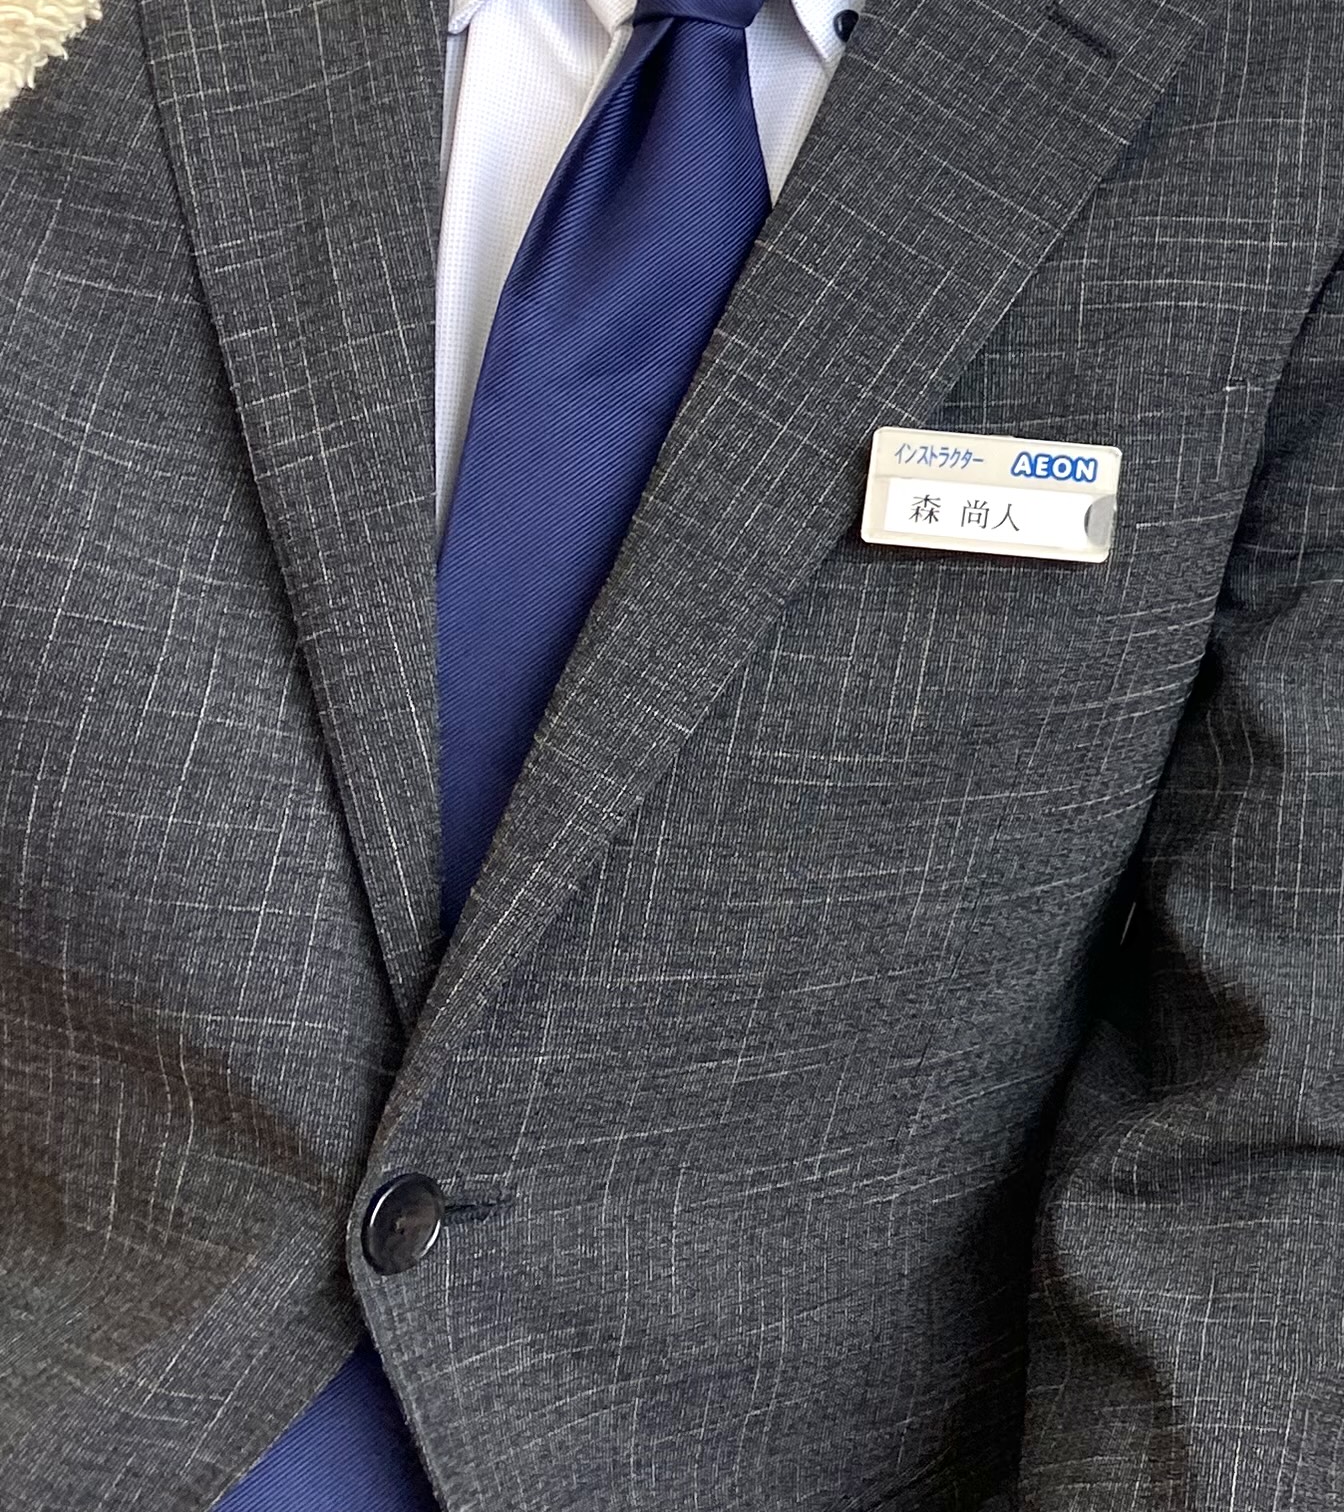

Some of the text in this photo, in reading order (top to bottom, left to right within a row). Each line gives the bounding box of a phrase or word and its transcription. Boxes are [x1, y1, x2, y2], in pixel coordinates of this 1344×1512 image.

[894, 442, 984, 470] インストラクター
[1012, 452, 1098, 483] AEON
[908, 494, 1020, 532] 森 尚人
